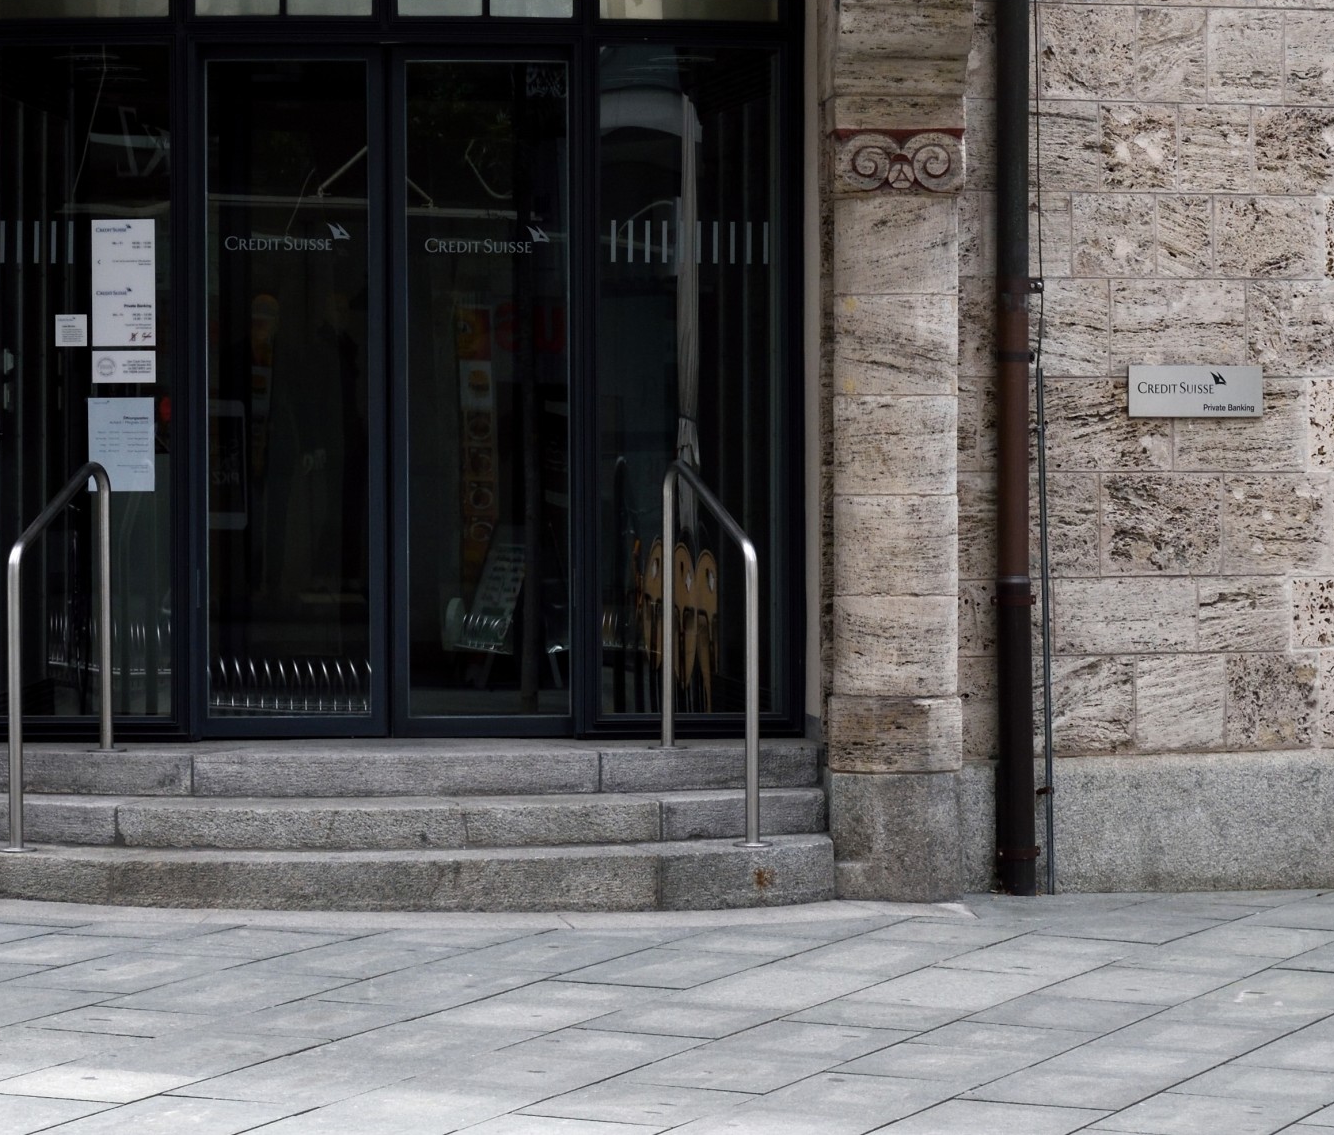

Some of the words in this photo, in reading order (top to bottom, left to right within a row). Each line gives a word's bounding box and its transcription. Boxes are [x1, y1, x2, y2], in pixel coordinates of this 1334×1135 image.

[224, 235, 282, 251] CREDIT
[283, 235, 333, 251] SUISSE
[424, 237, 482, 254] CREDIT
[483, 238, 533, 254] SUISSE
[1137, 381, 1178, 395] CREDIT
[1179, 381, 1215, 395] SUISSE
[1203, 403, 1227, 412] Private
[1227, 403, 1255, 413] Banking
